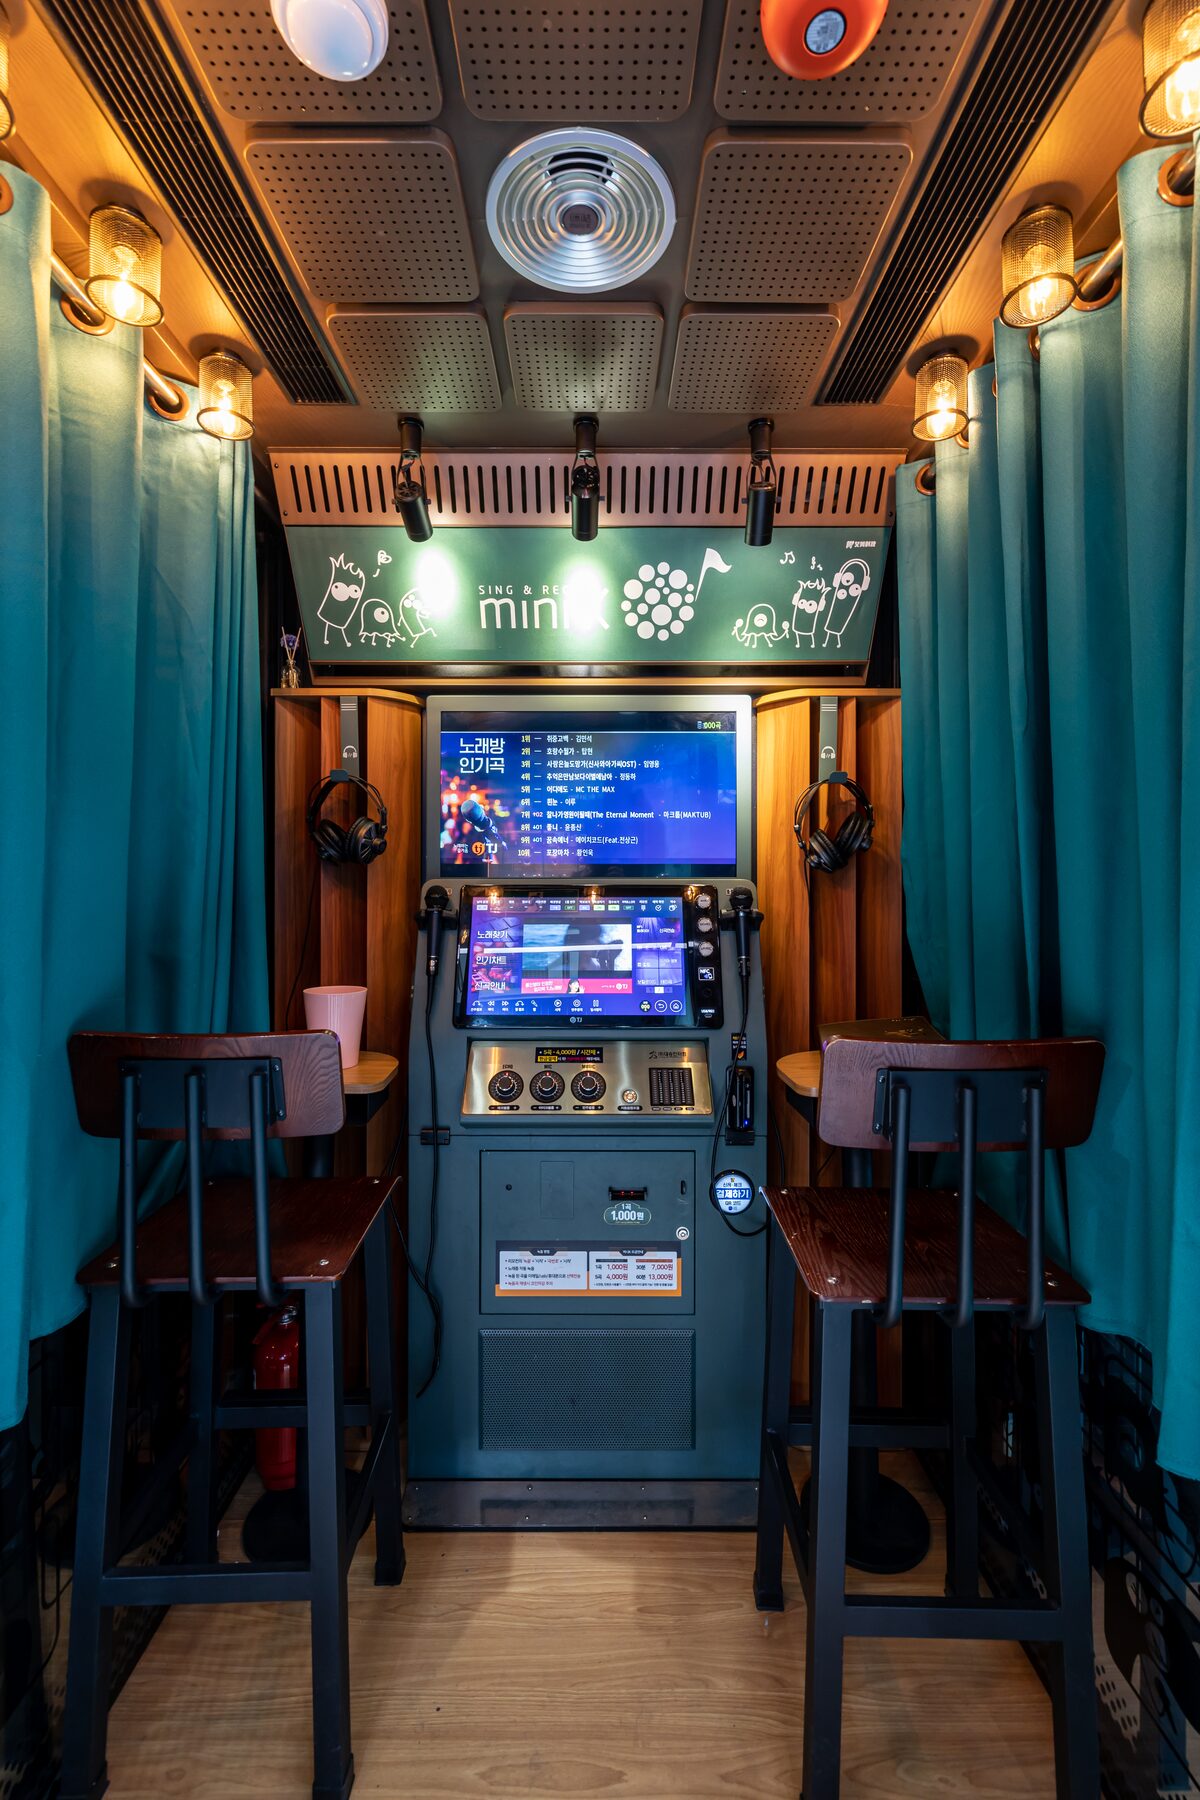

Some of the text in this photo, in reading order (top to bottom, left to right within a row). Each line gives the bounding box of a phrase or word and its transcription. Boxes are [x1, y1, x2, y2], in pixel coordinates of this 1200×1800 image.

[478, 585, 513, 595] SING
[523, 585, 532, 595] &
[521, 734, 531, 743] 1위
[459, 737, 506, 754] 노래방
[521, 747, 531, 756] 2위
[459, 757, 505, 774] 인기곡
[521, 759, 531, 769] 3위
[521, 772, 531, 781] 4위
[521, 785, 531, 793] 5위
[575, 785, 584, 793] MC
[587, 785, 599, 793] THE
[602, 785, 615, 793] MAX
[521, 798, 531, 806] 6위
[521, 811, 531, 819] 7위
[605, 811, 628, 819] Eternal
[629, 811, 654, 819] Moment
[521, 836, 531, 844] 9위
[486, 843, 497, 854] TJ
[517, 849, 531, 857] 10위
[477, 930, 508, 939] 노래찾기
[475, 955, 507, 965] 인기차트
[716, 1188, 750, 1199] 결제하기
[611, 1210, 644, 1221] 1,000원
